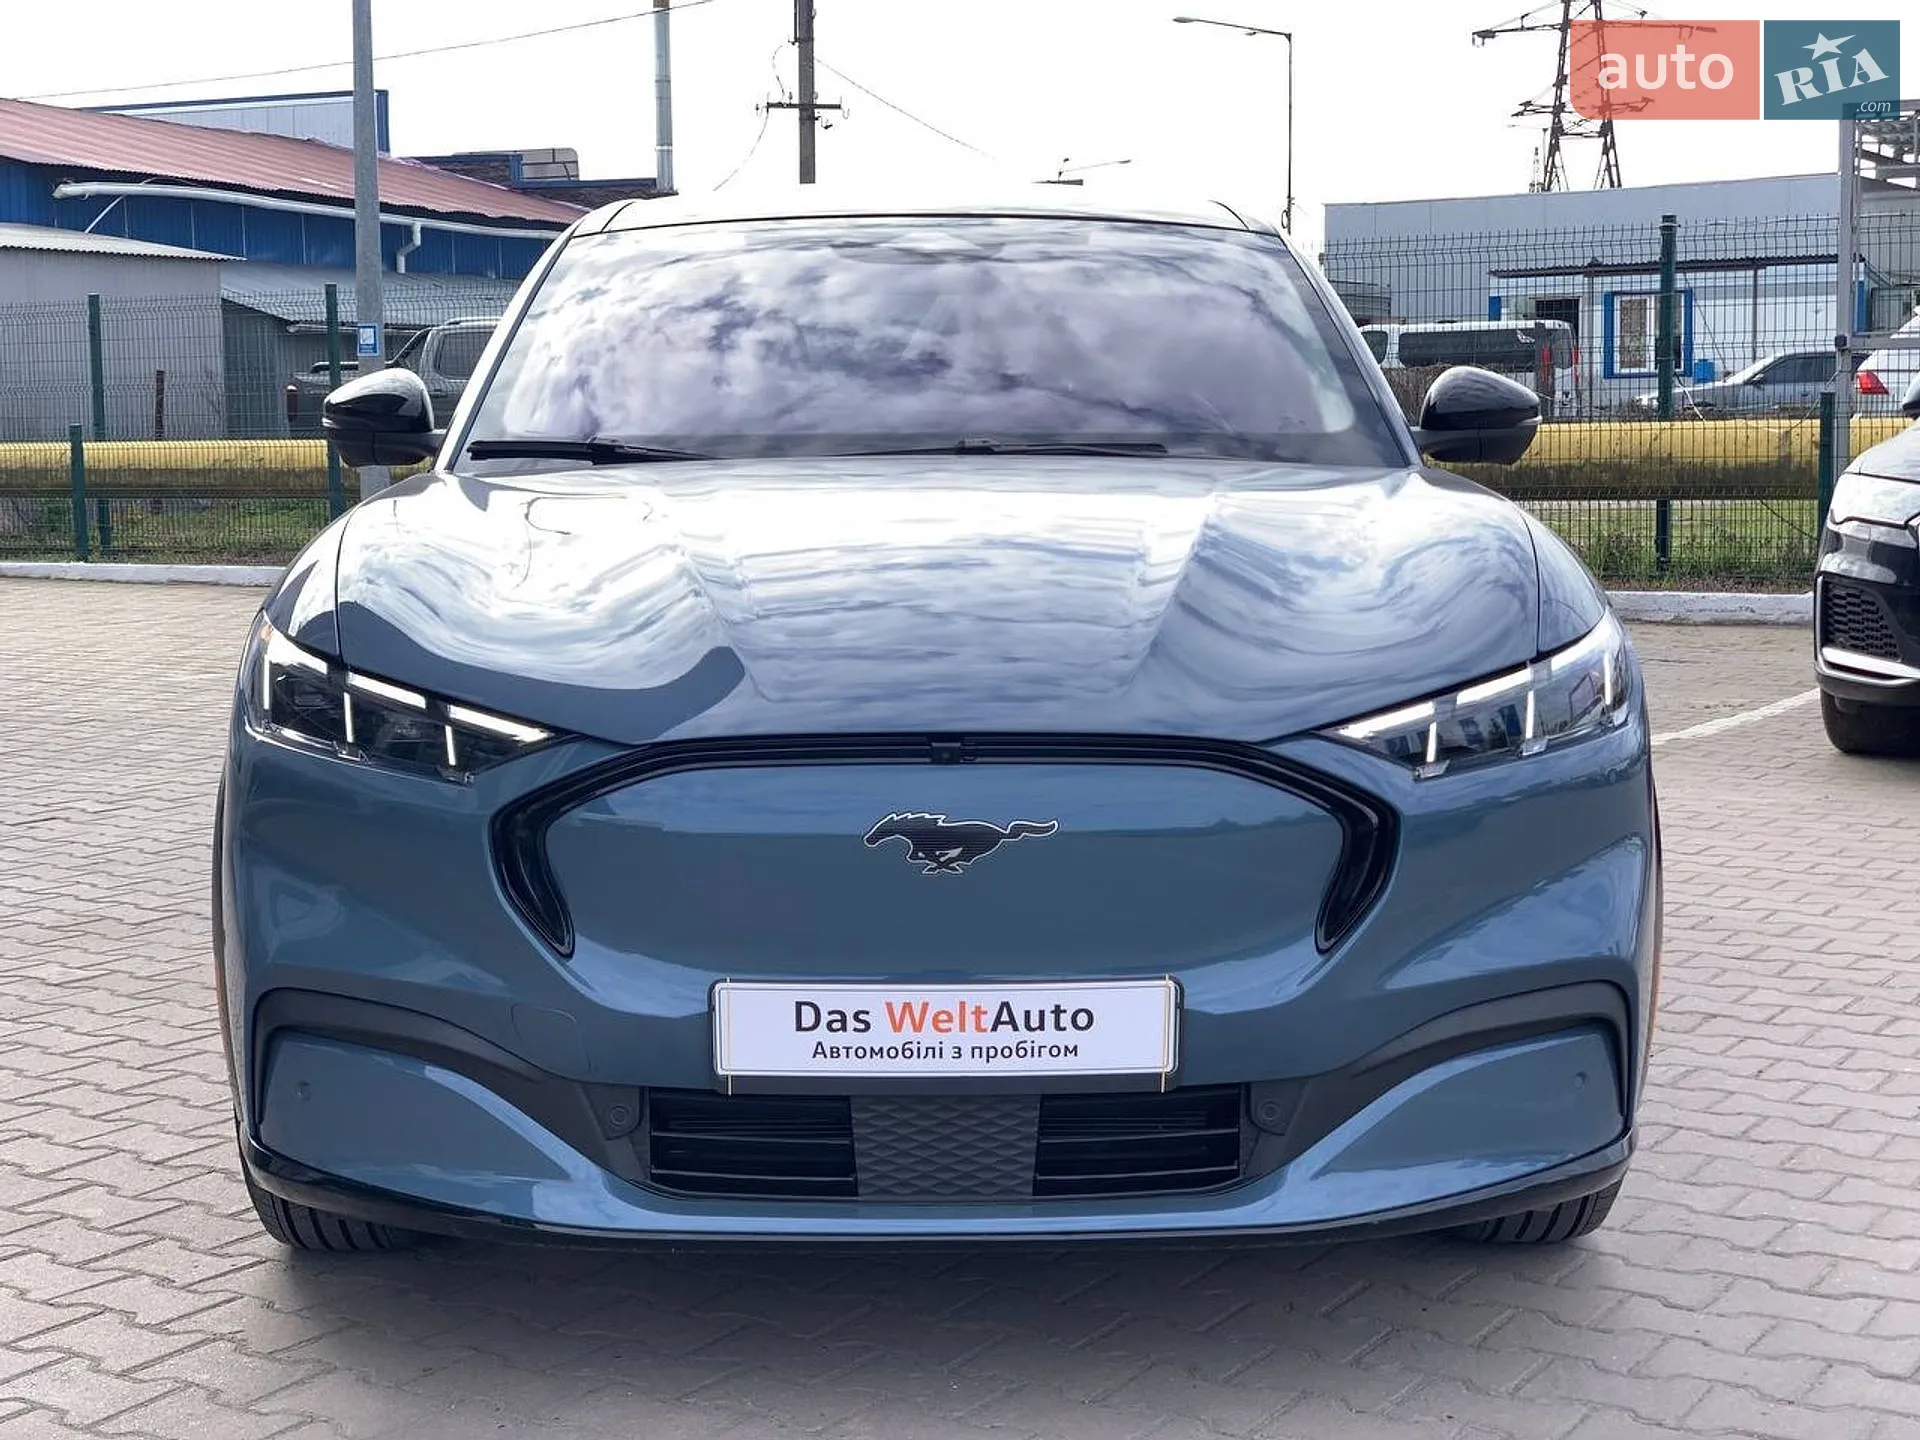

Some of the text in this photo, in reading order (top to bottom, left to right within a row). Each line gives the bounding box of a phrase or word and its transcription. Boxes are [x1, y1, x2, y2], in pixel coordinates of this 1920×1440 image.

[794, 1000, 1095, 1034] Das WeltAuto
[811, 1039, 1079, 1064] Автомобілі з пробігом
